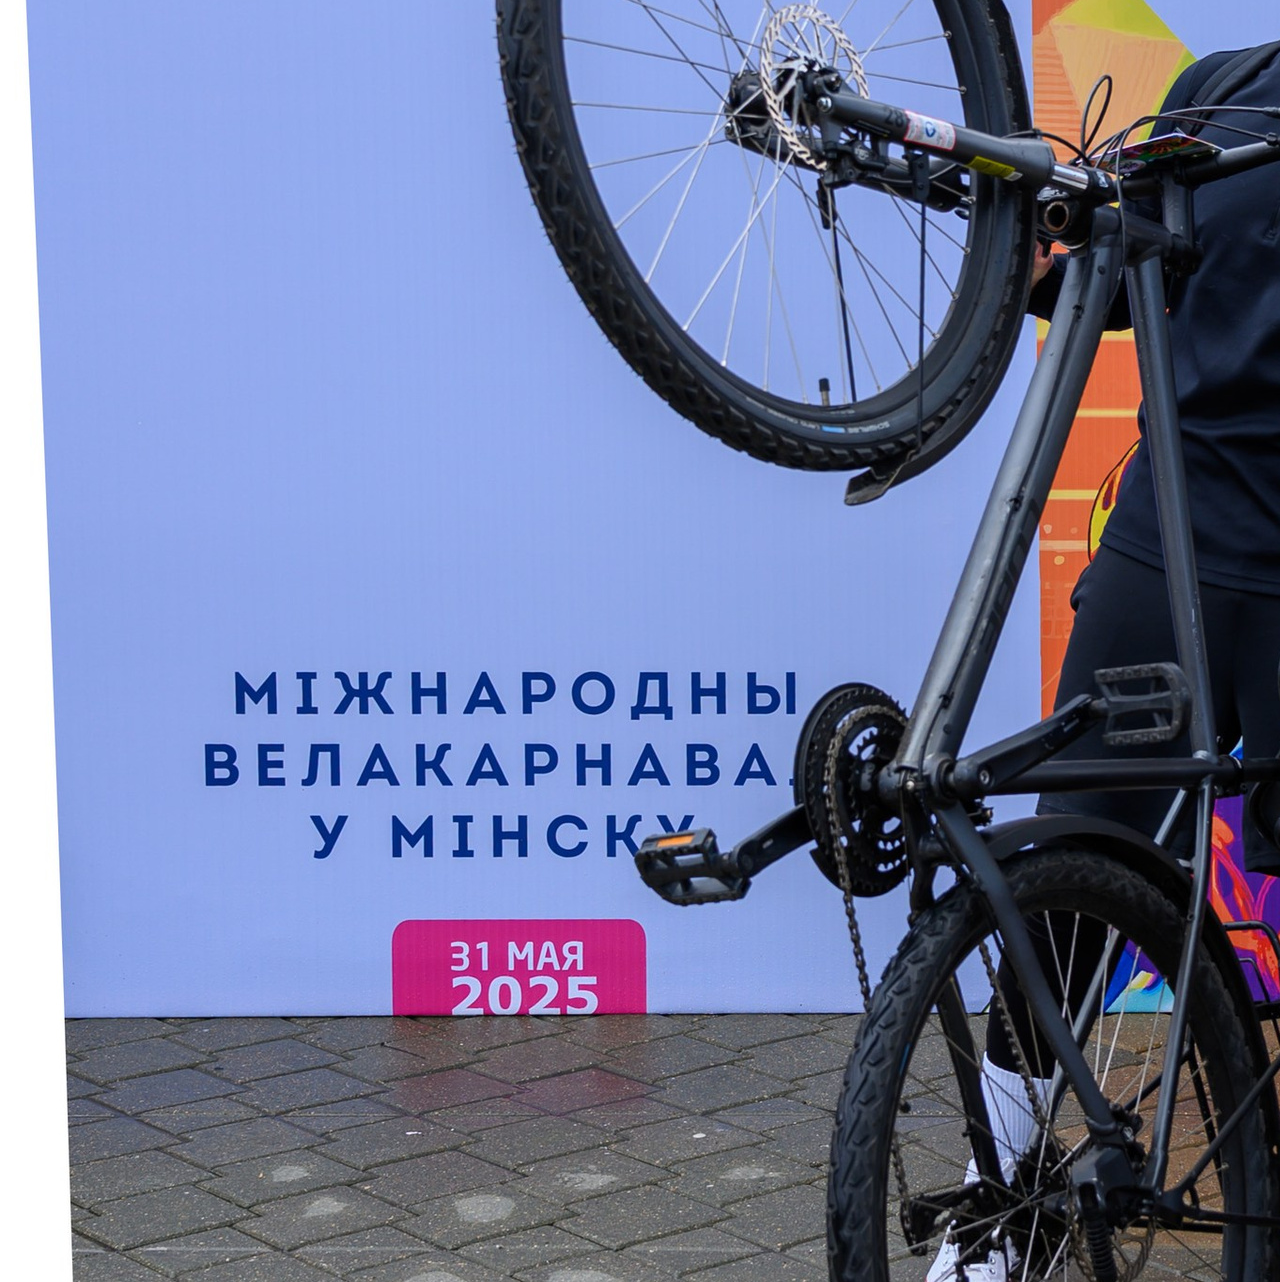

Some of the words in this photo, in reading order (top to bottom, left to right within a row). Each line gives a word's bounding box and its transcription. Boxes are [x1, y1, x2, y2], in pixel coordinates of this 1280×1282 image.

[235, 671, 797, 720] МІЖНАРОДНЫ
[204, 743, 796, 786] ВЕЛАКАРНАВА
[310, 815, 348, 859] У
[450, 940, 489, 971] 31
[508, 940, 584, 971] МАЯ
[451, 976, 599, 1015] 2025
